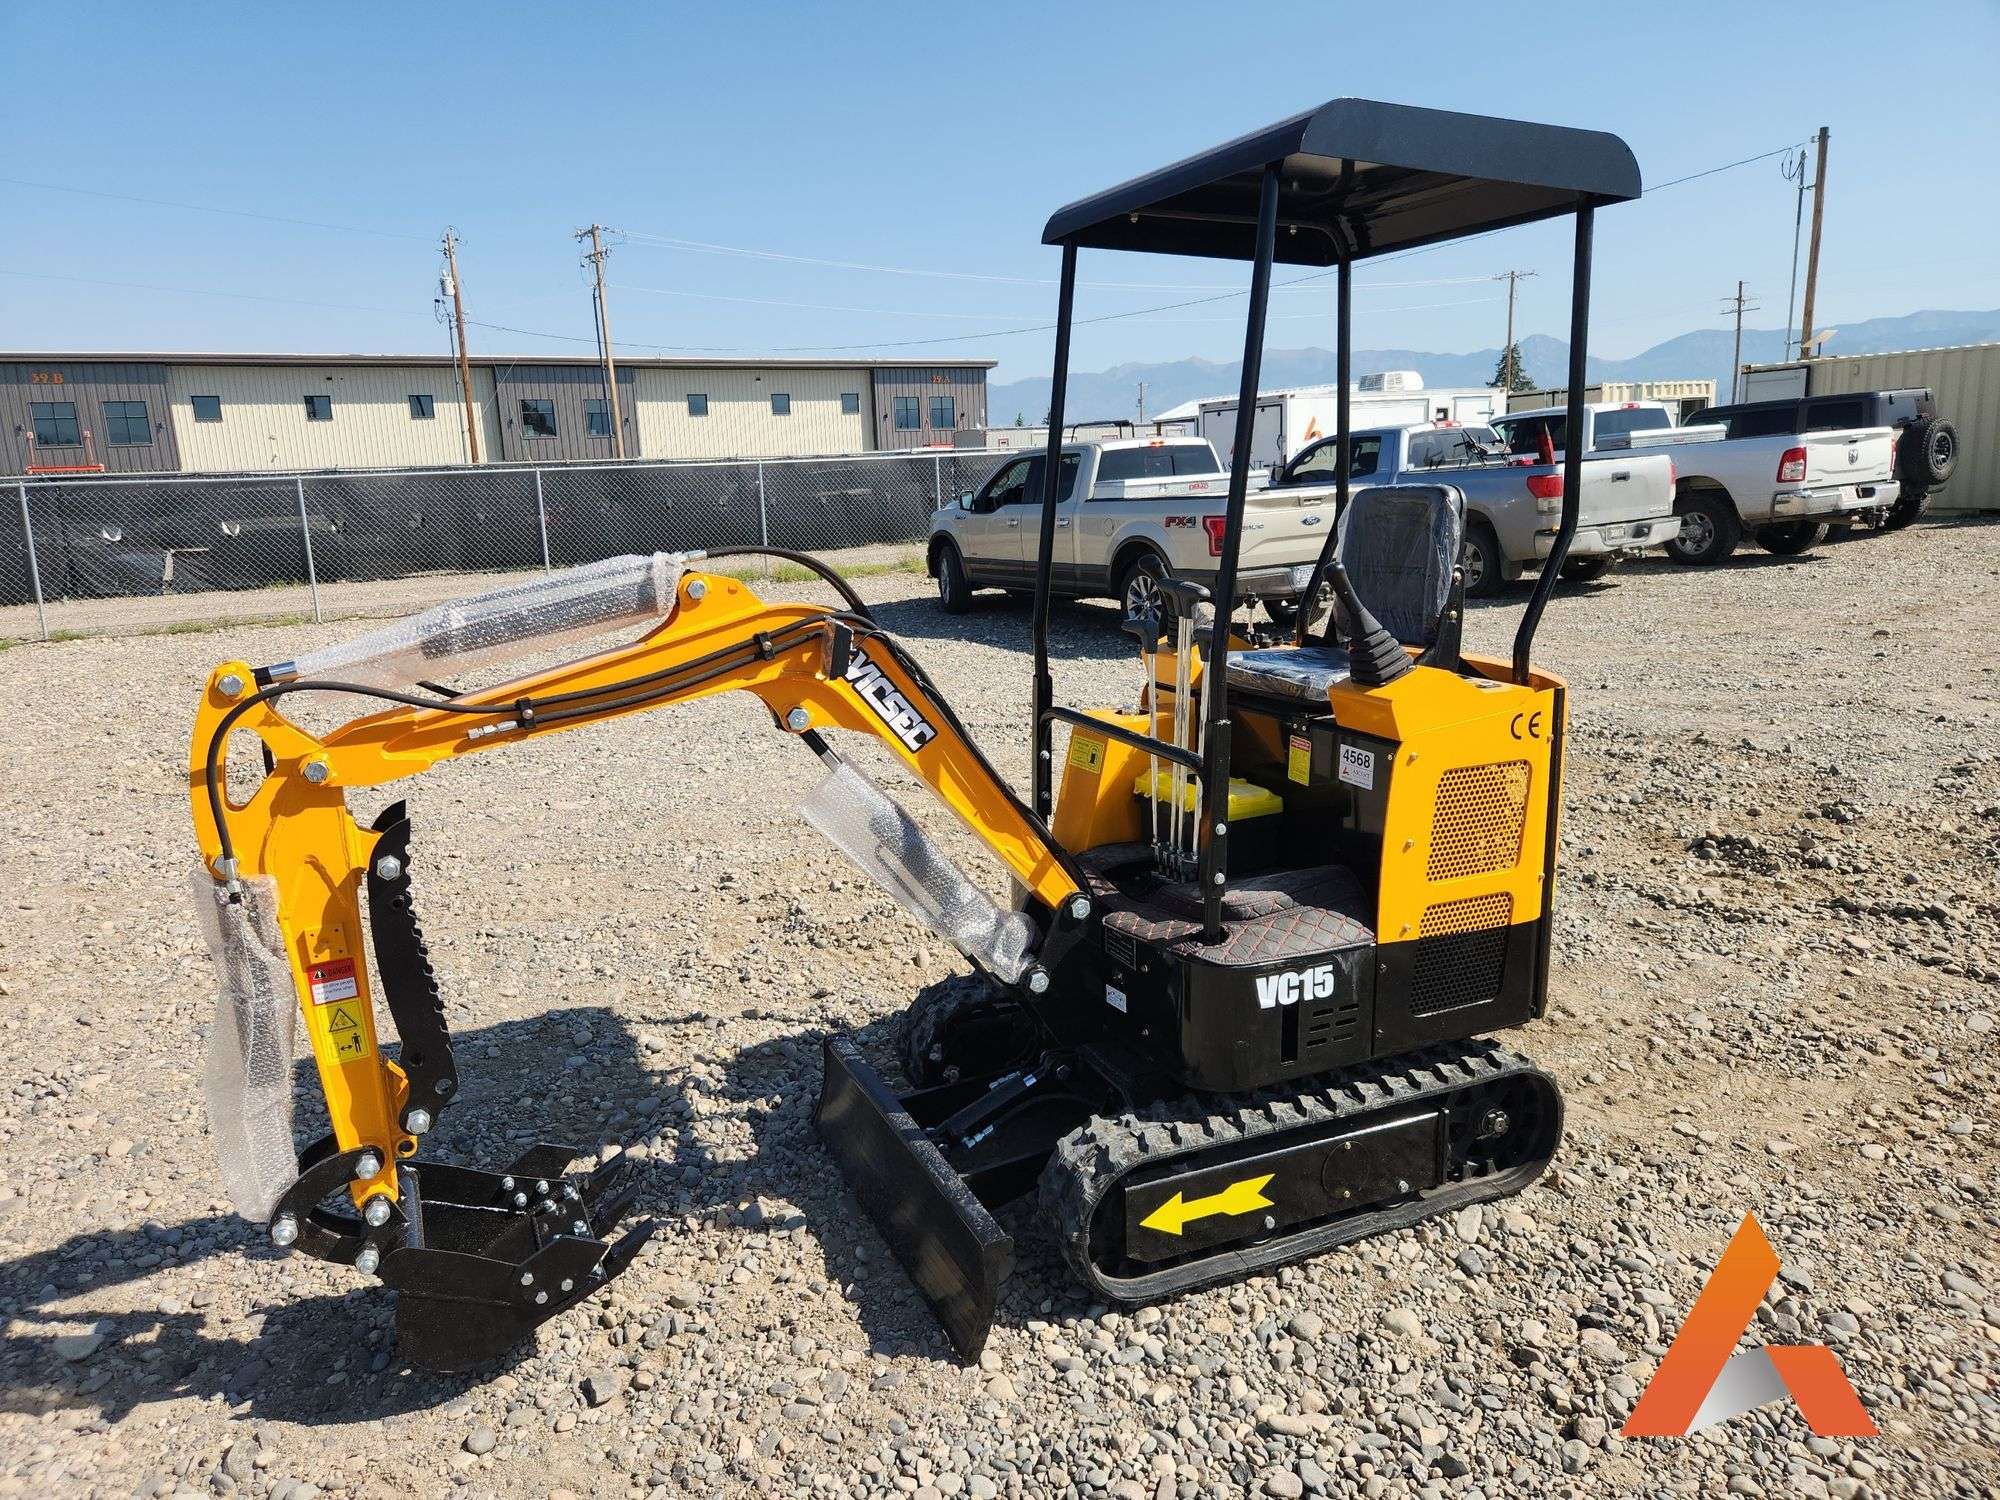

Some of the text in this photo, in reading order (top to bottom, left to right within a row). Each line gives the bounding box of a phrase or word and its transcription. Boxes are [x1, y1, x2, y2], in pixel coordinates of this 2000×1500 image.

[1165, 516, 1197, 528] FX4
[1510, 711, 1542, 740] CE
[1343, 748, 1371, 769] 4568
[1255, 964, 1335, 1010] VC15
